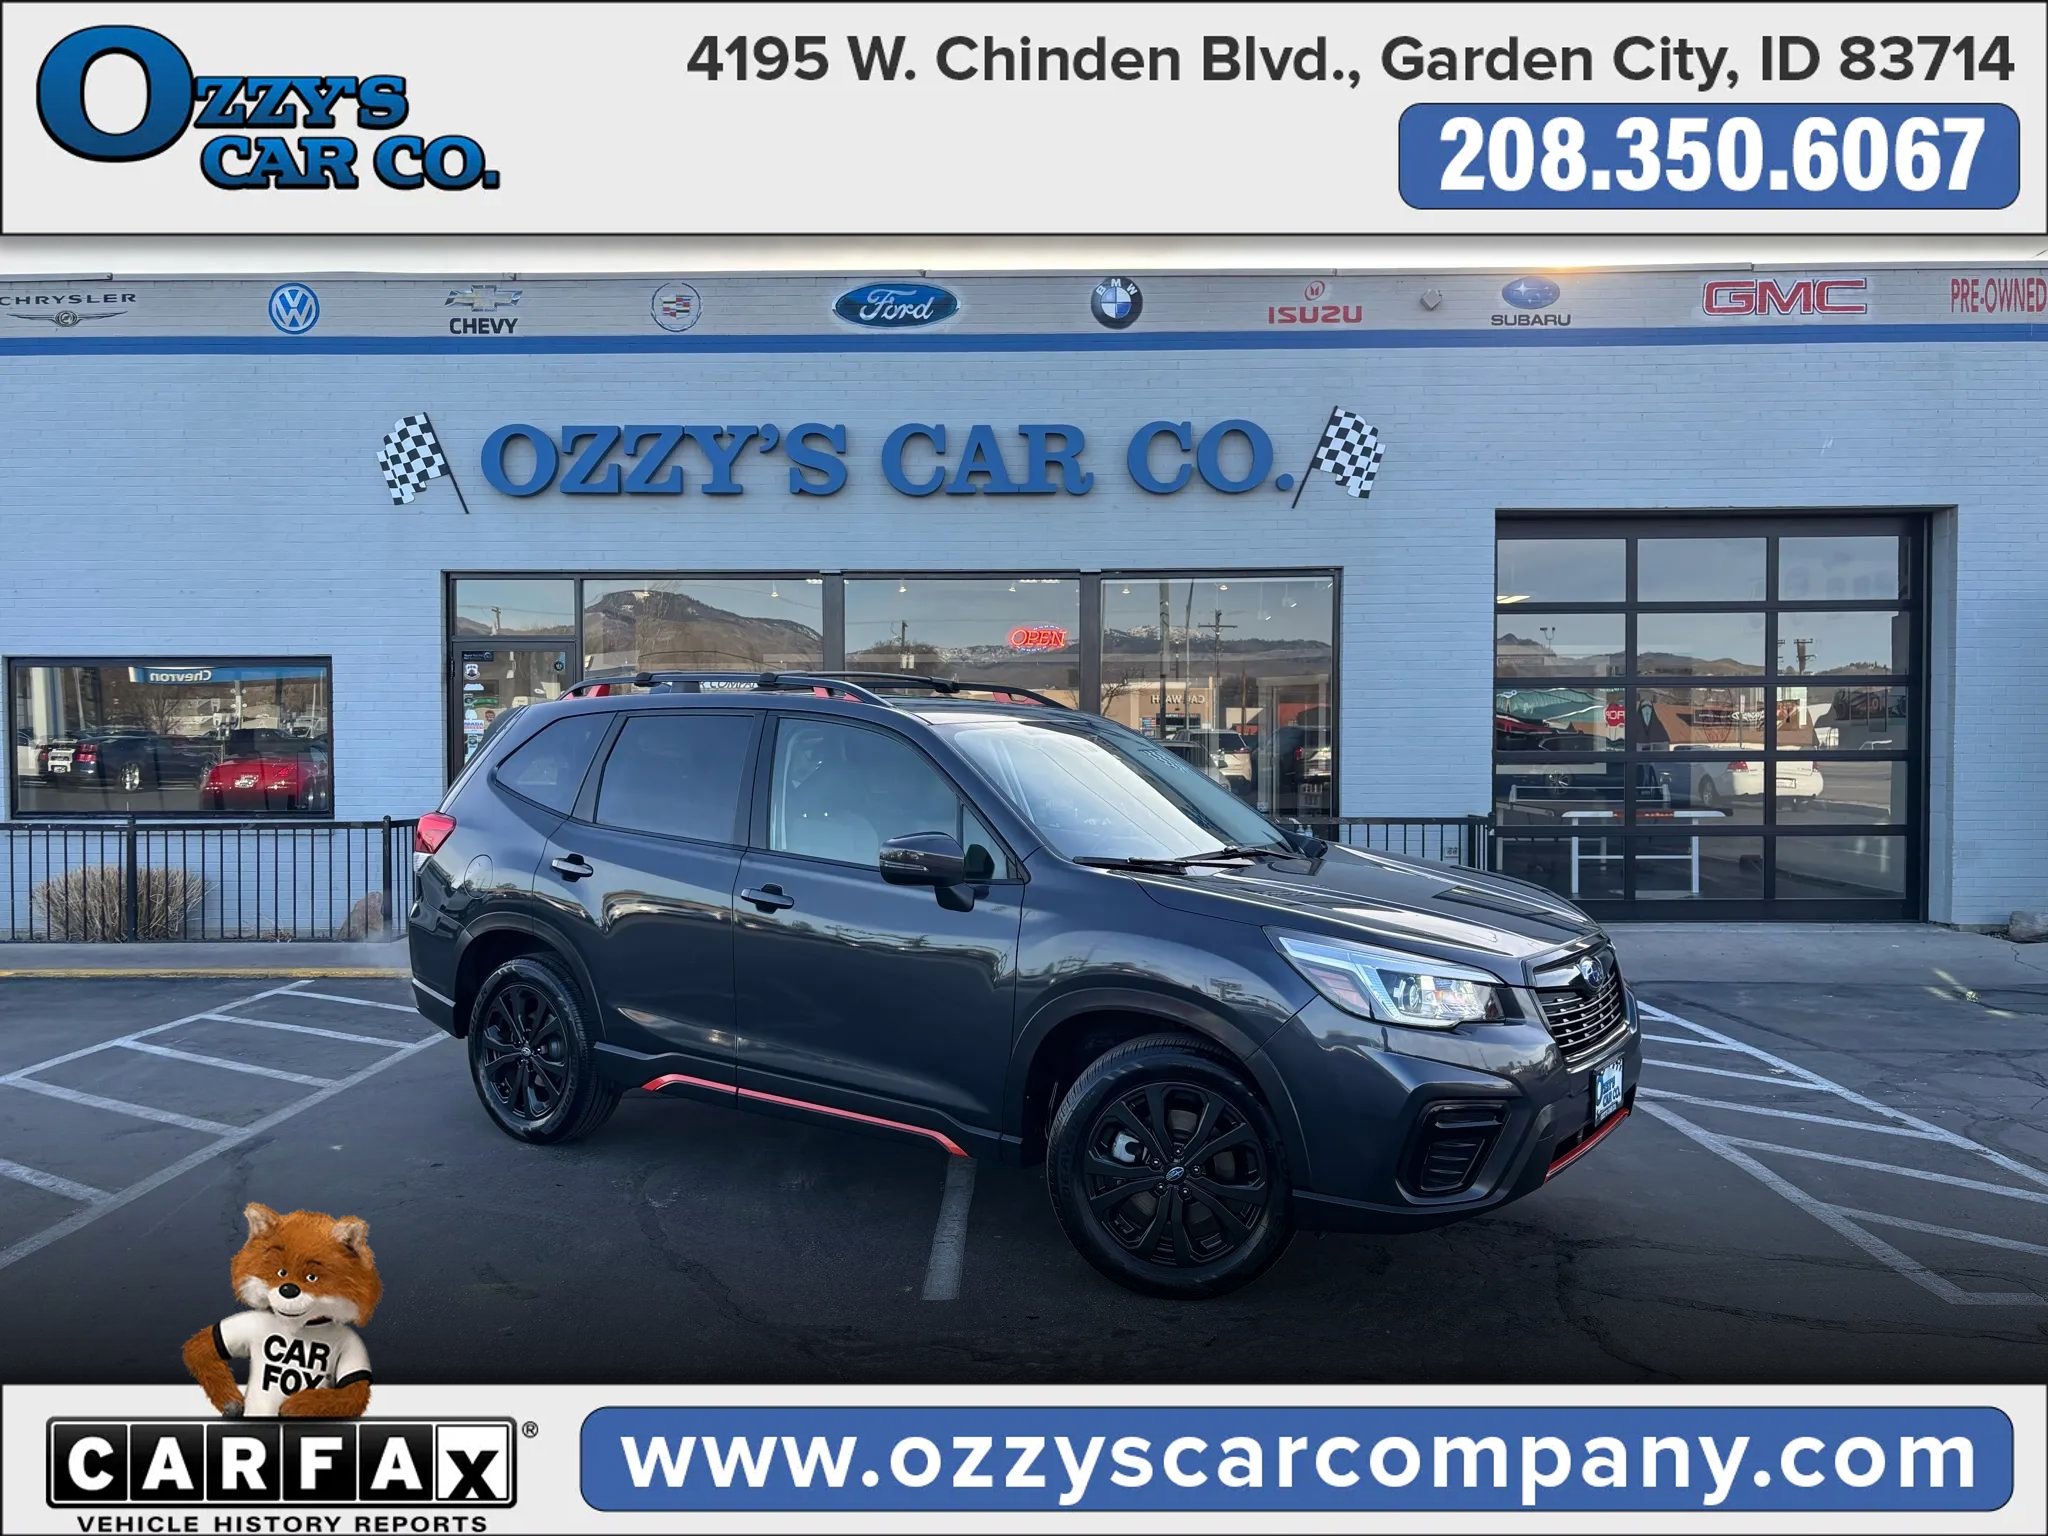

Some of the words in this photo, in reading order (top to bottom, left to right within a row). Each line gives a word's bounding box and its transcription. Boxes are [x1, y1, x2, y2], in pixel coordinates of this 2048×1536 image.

[0, 293, 137, 306] CHRYSLER
[860, 289, 936, 320] Ford
[1703, 278, 1867, 315] GMC
[1950, 278, 2046, 313] PRE-OWNED
[1268, 306, 1362, 324] ISUZU
[1491, 314, 1571, 327] SUBARU
[449, 317, 518, 335] CHEVY
[881, 423, 1094, 496] CAR
[1126, 419, 1294, 494] CO.
[1011, 629, 1067, 647] OPEN
